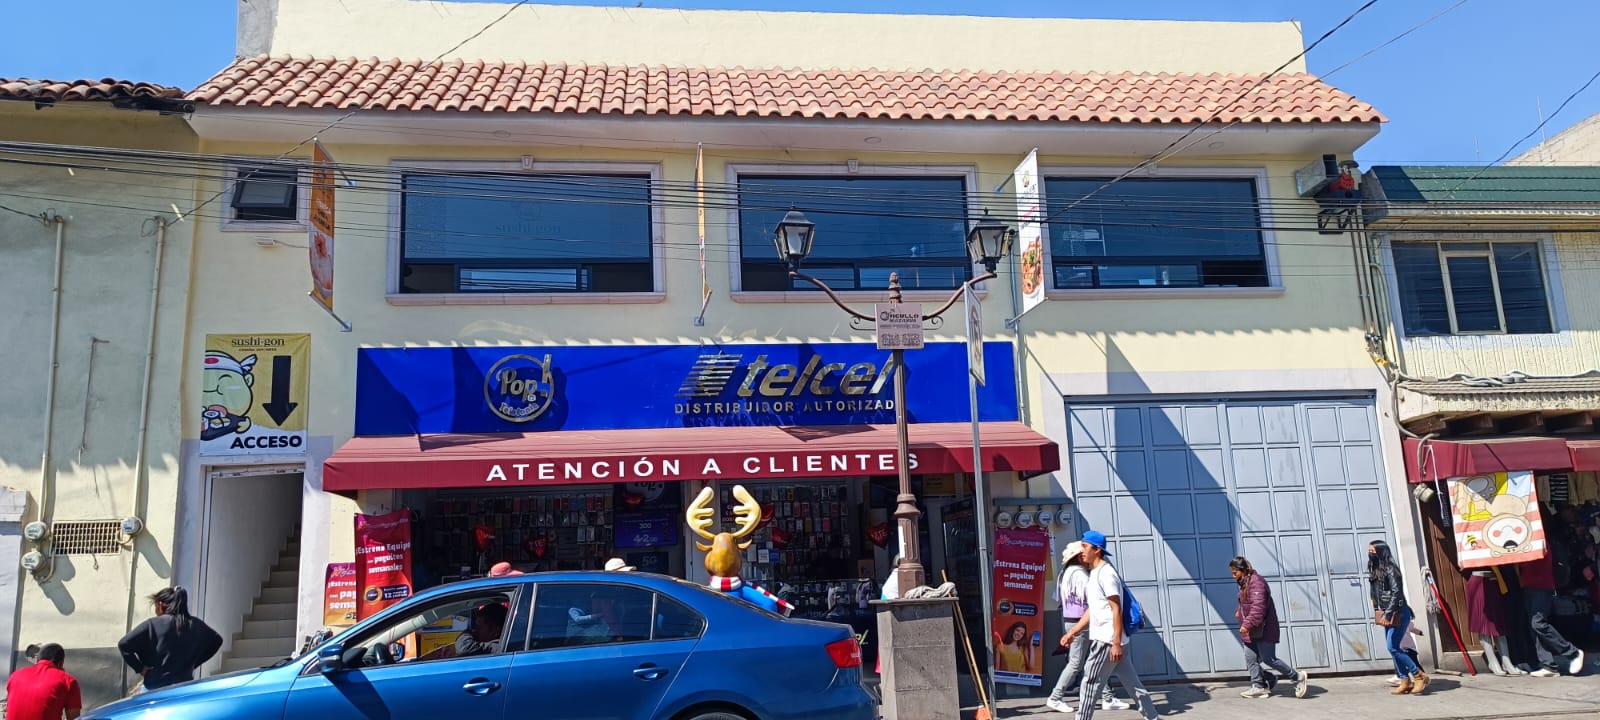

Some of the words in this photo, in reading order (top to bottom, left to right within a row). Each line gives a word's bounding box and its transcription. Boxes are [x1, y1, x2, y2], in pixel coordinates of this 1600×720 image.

[231, 336, 285, 348] sushi-gon
[496, 354, 552, 402] Pop!
[737, 353, 893, 398] telcel
[674, 400, 794, 414] DISTRIBUIDOR
[804, 399, 895, 412] AUTORIZAD
[230, 435, 303, 449] ACCESO
[486, 457, 680, 482] ATENCIÓN
[702, 458, 722, 475] A
[743, 453, 919, 474] CLIENTES
